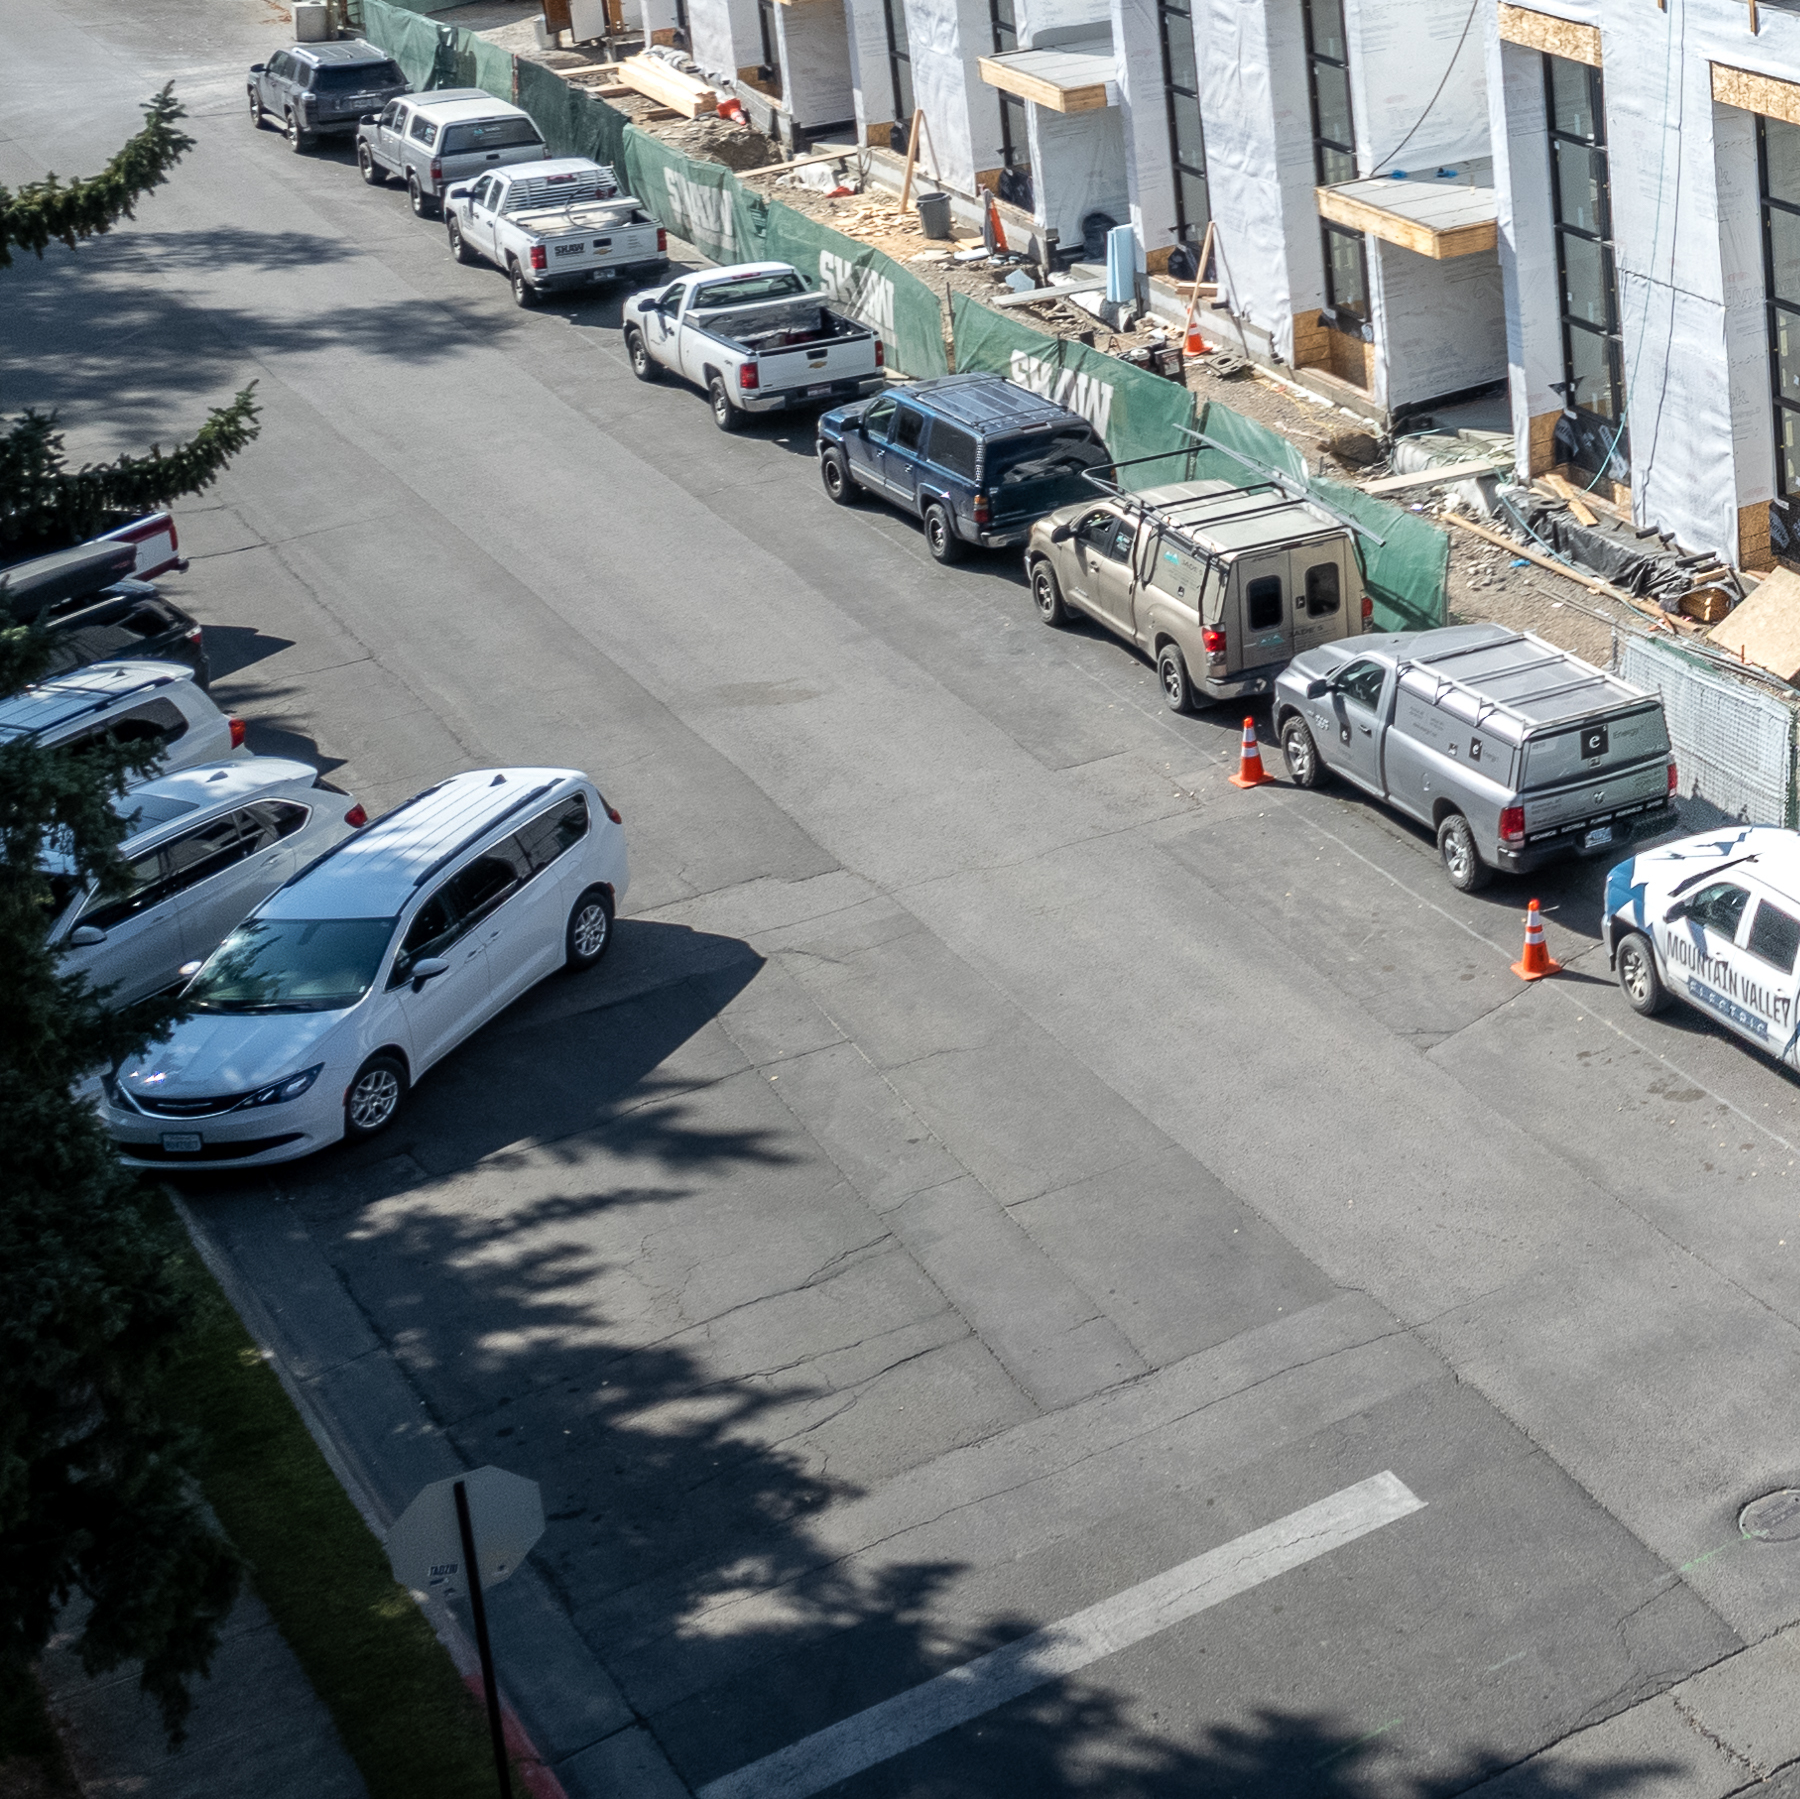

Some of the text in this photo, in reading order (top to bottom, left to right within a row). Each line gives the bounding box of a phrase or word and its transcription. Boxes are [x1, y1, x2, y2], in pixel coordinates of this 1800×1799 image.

[554, 243, 585, 253] SHAW
[1667, 931, 1791, 1027] MOUNTAIN VALLEY
[1689, 980, 1766, 1036] ELECTRIC
